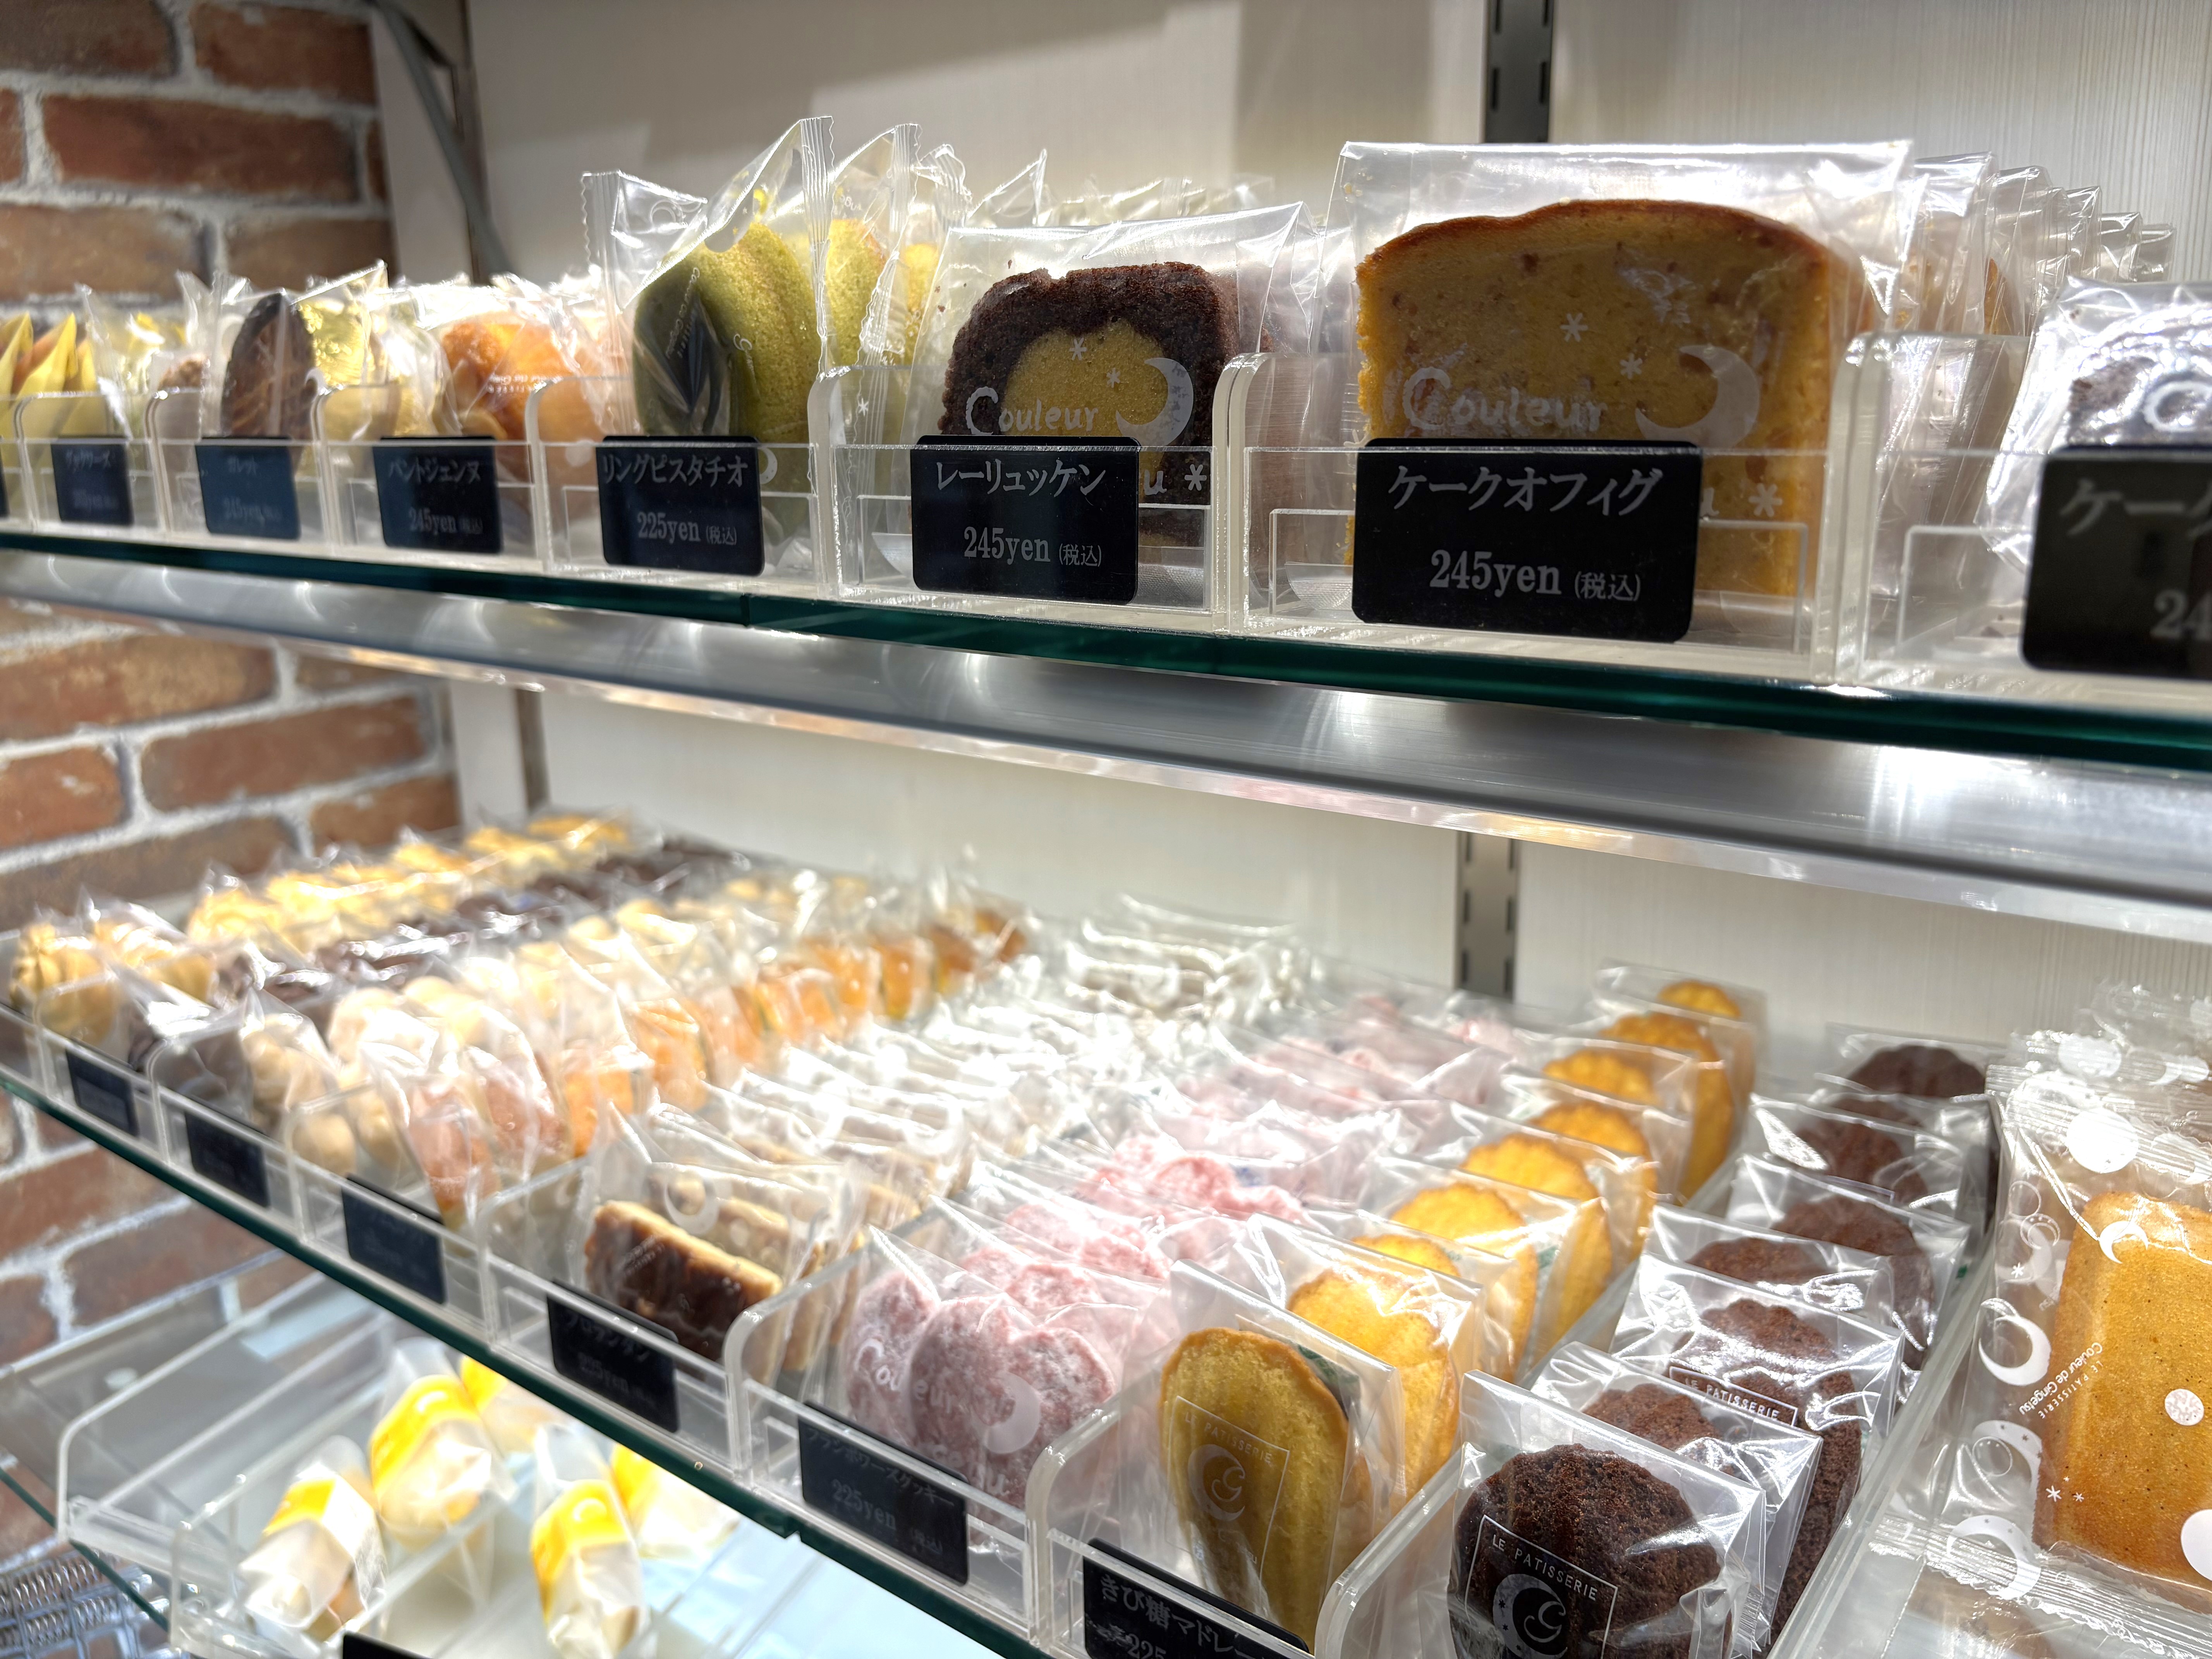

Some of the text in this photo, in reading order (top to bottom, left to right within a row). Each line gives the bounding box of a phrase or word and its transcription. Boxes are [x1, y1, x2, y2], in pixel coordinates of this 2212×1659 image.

[965, 386, 1099, 435] Couleur
[1403, 366, 1608, 431] Couleur
[602, 453, 748, 488] リングピスタチオ
[936, 459, 1106, 497] レーリュッケン
[1388, 465, 1664, 517] ケークオフィグ
[408, 507, 457, 535] 245yen
[637, 512, 737, 546] 225yen (税込)
[2059, 477, 2212, 537] ケー
[964, 527, 1101, 567] 245yen (税込)
[1429, 549, 1642, 602] 245yen (税込)
[2056, 1369, 2069, 1384] de
[2068, 1342, 2103, 1374] Couleur
[831, 1478, 896, 1531] 225yen
[1492, 1534, 1598, 1602] LE PATISSERIE
[1100, 1573, 1266, 1659] きび糖マドレー
